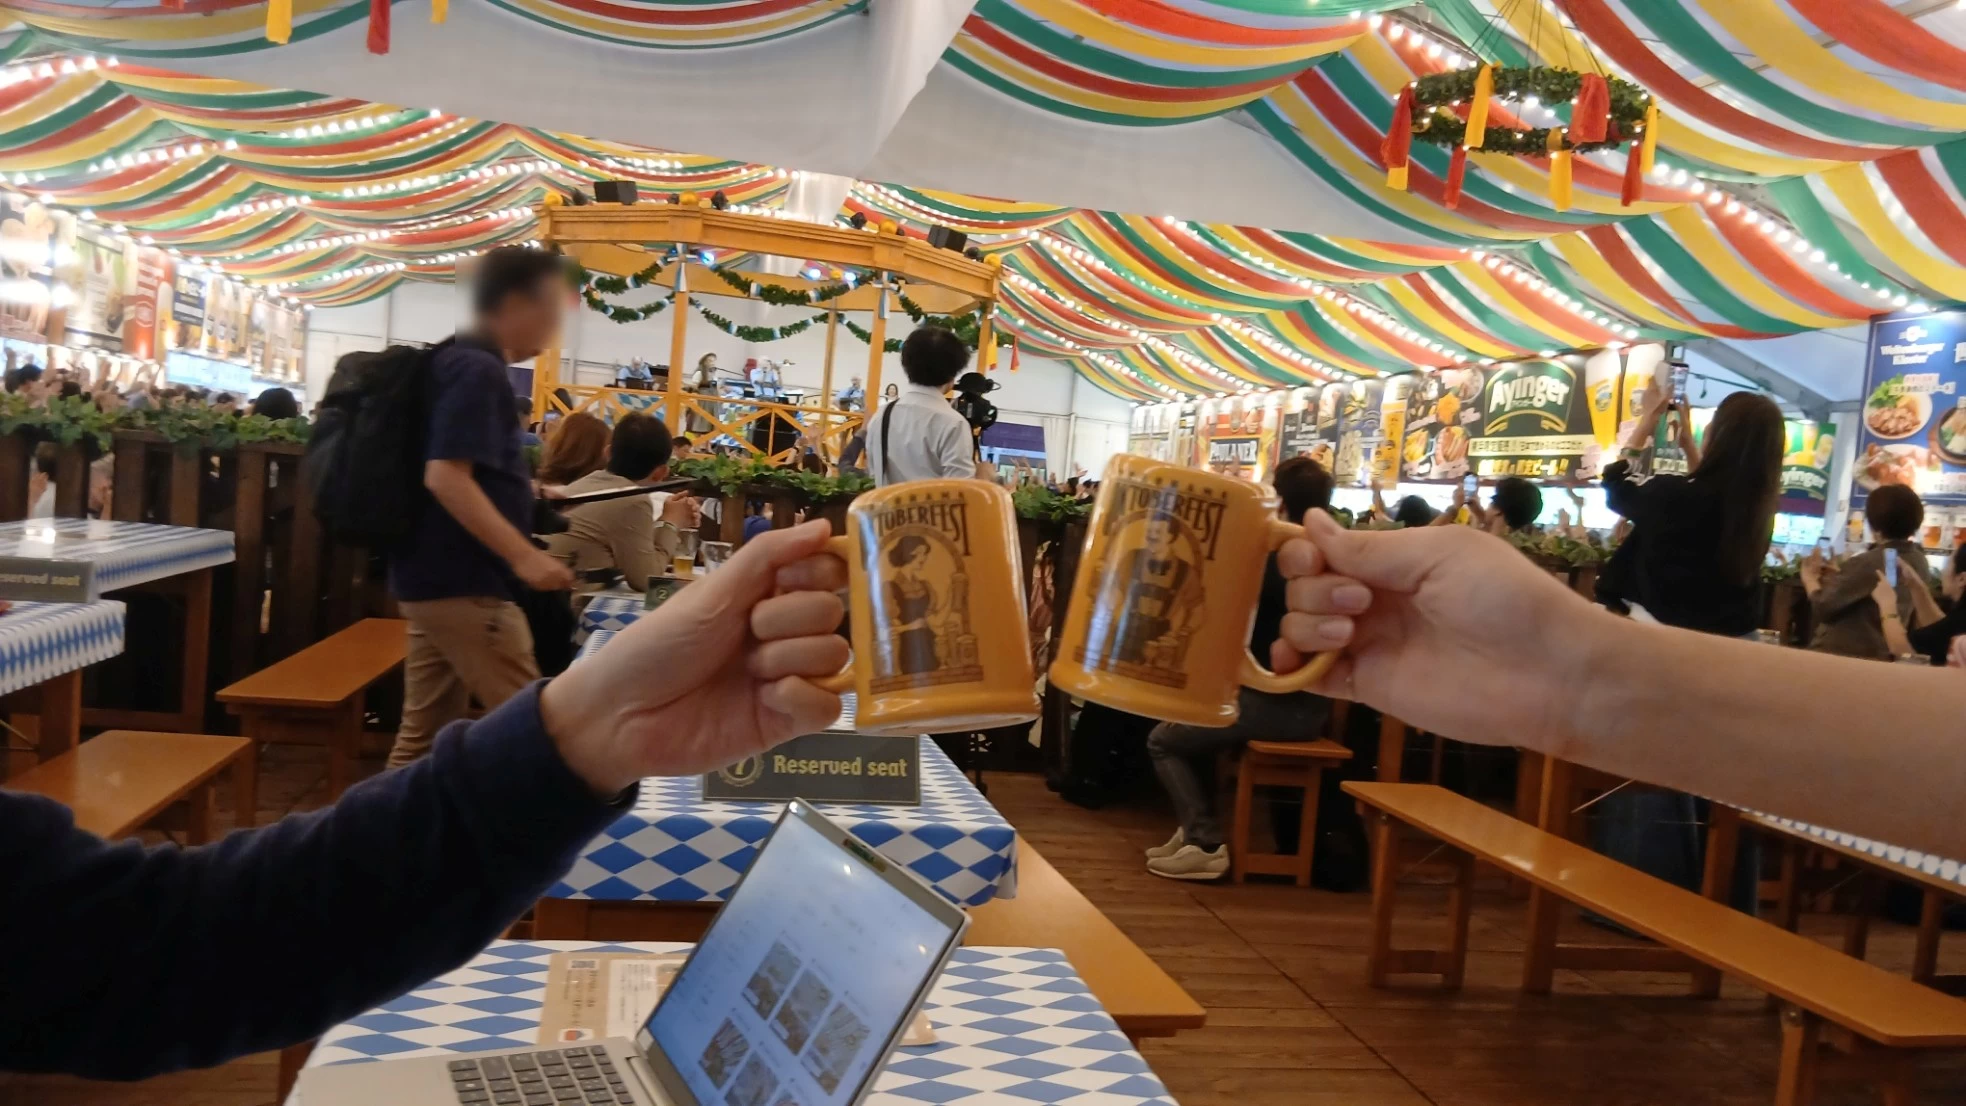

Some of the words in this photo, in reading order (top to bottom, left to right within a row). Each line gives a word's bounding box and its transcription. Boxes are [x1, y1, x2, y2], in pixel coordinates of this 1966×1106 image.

[1489, 369, 1569, 413] Ayinger
[1780, 466, 1827, 489] yinger
[860, 502, 972, 560] TOBERFEST
[773, 754, 861, 776] Reserved
[867, 759, 908, 777] seat
